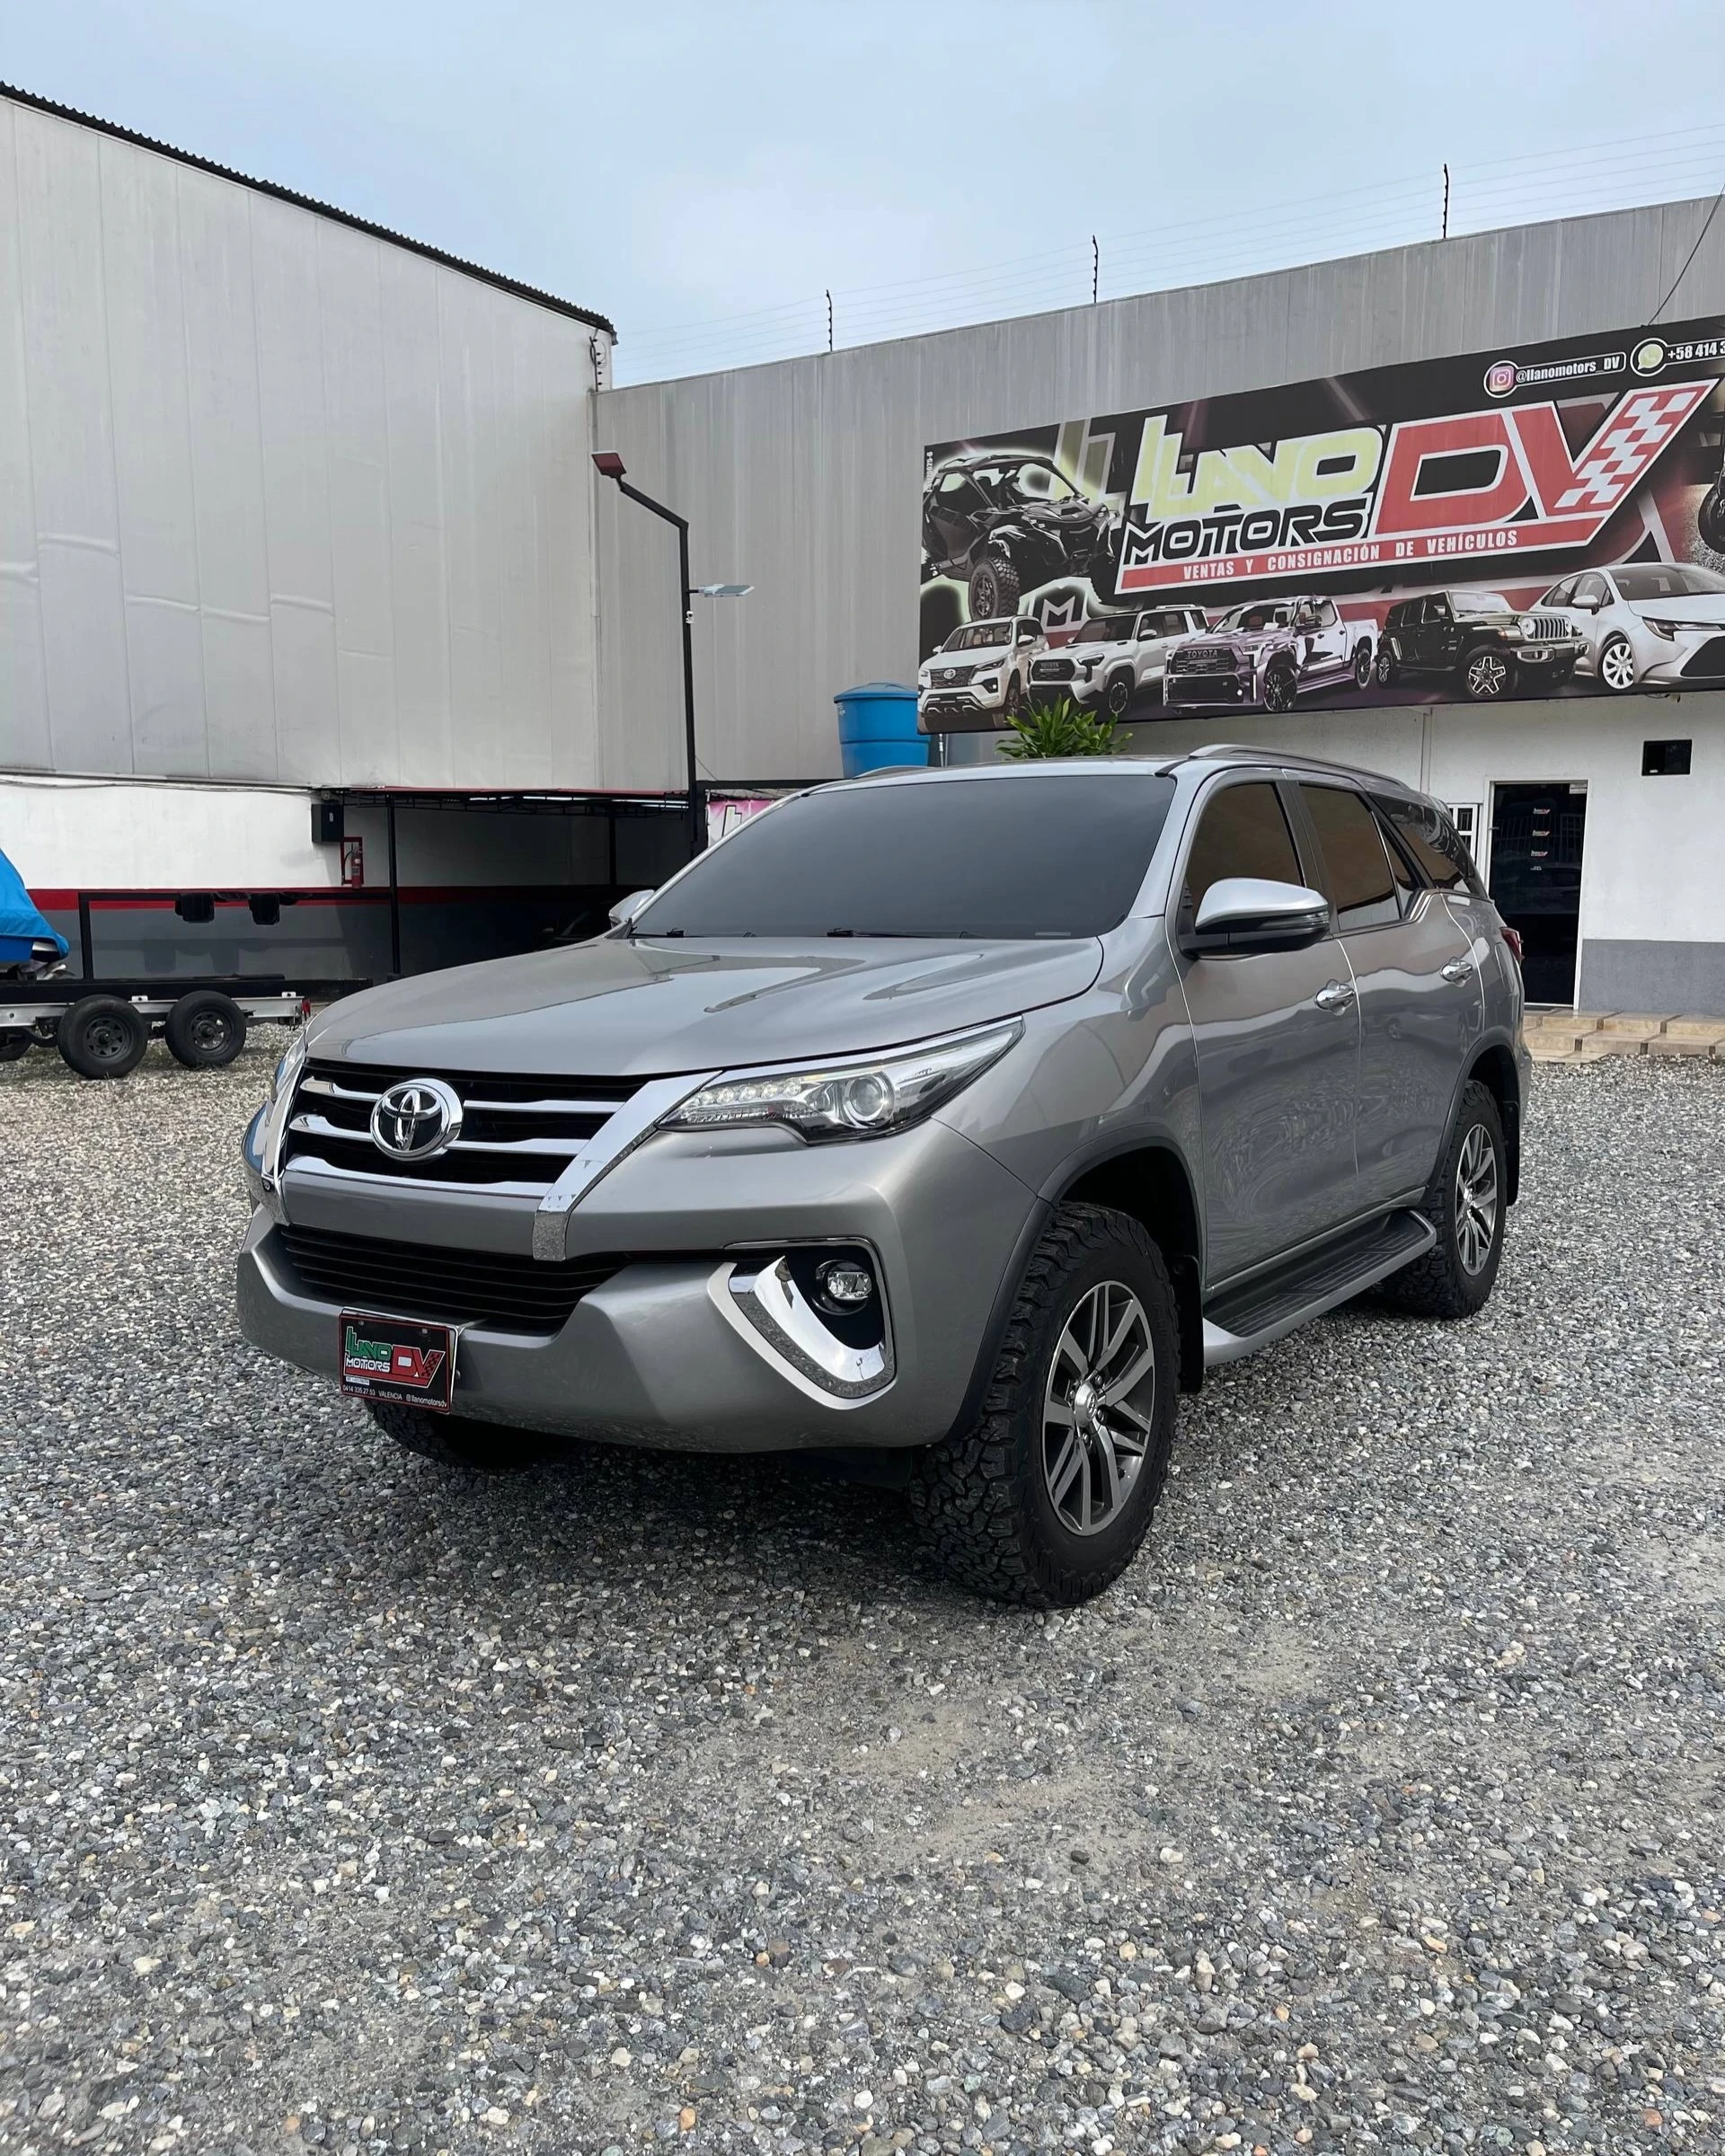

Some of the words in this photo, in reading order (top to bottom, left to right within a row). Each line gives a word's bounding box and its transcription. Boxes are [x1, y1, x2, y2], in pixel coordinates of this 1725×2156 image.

[1668, 346, 1693, 360] +58
[1694, 341, 1717, 358] 414
[1516, 356, 1621, 384] @llanomotors_DV
[1130, 414, 1383, 523] LLANO
[1375, 378, 1720, 535] DV
[1123, 498, 1370, 565] MOTORS
[1183, 561, 1234, 580] VENTAS
[1245, 559, 1254, 574] Y
[1267, 543, 1380, 571] CONSIGNACIÓN
[1395, 541, 1414, 558] DE
[1427, 529, 1518, 555] VEHÍCULOS
[1187, 649, 1218, 658] TOYOTA
[345, 1325, 394, 1361] LLANO
[392, 1344, 447, 1379] DV
[345, 1354, 391, 1374] MOTORS
[342, 1384, 355, 1393] 0414
[377, 1390, 402, 1401] VALENCIA
